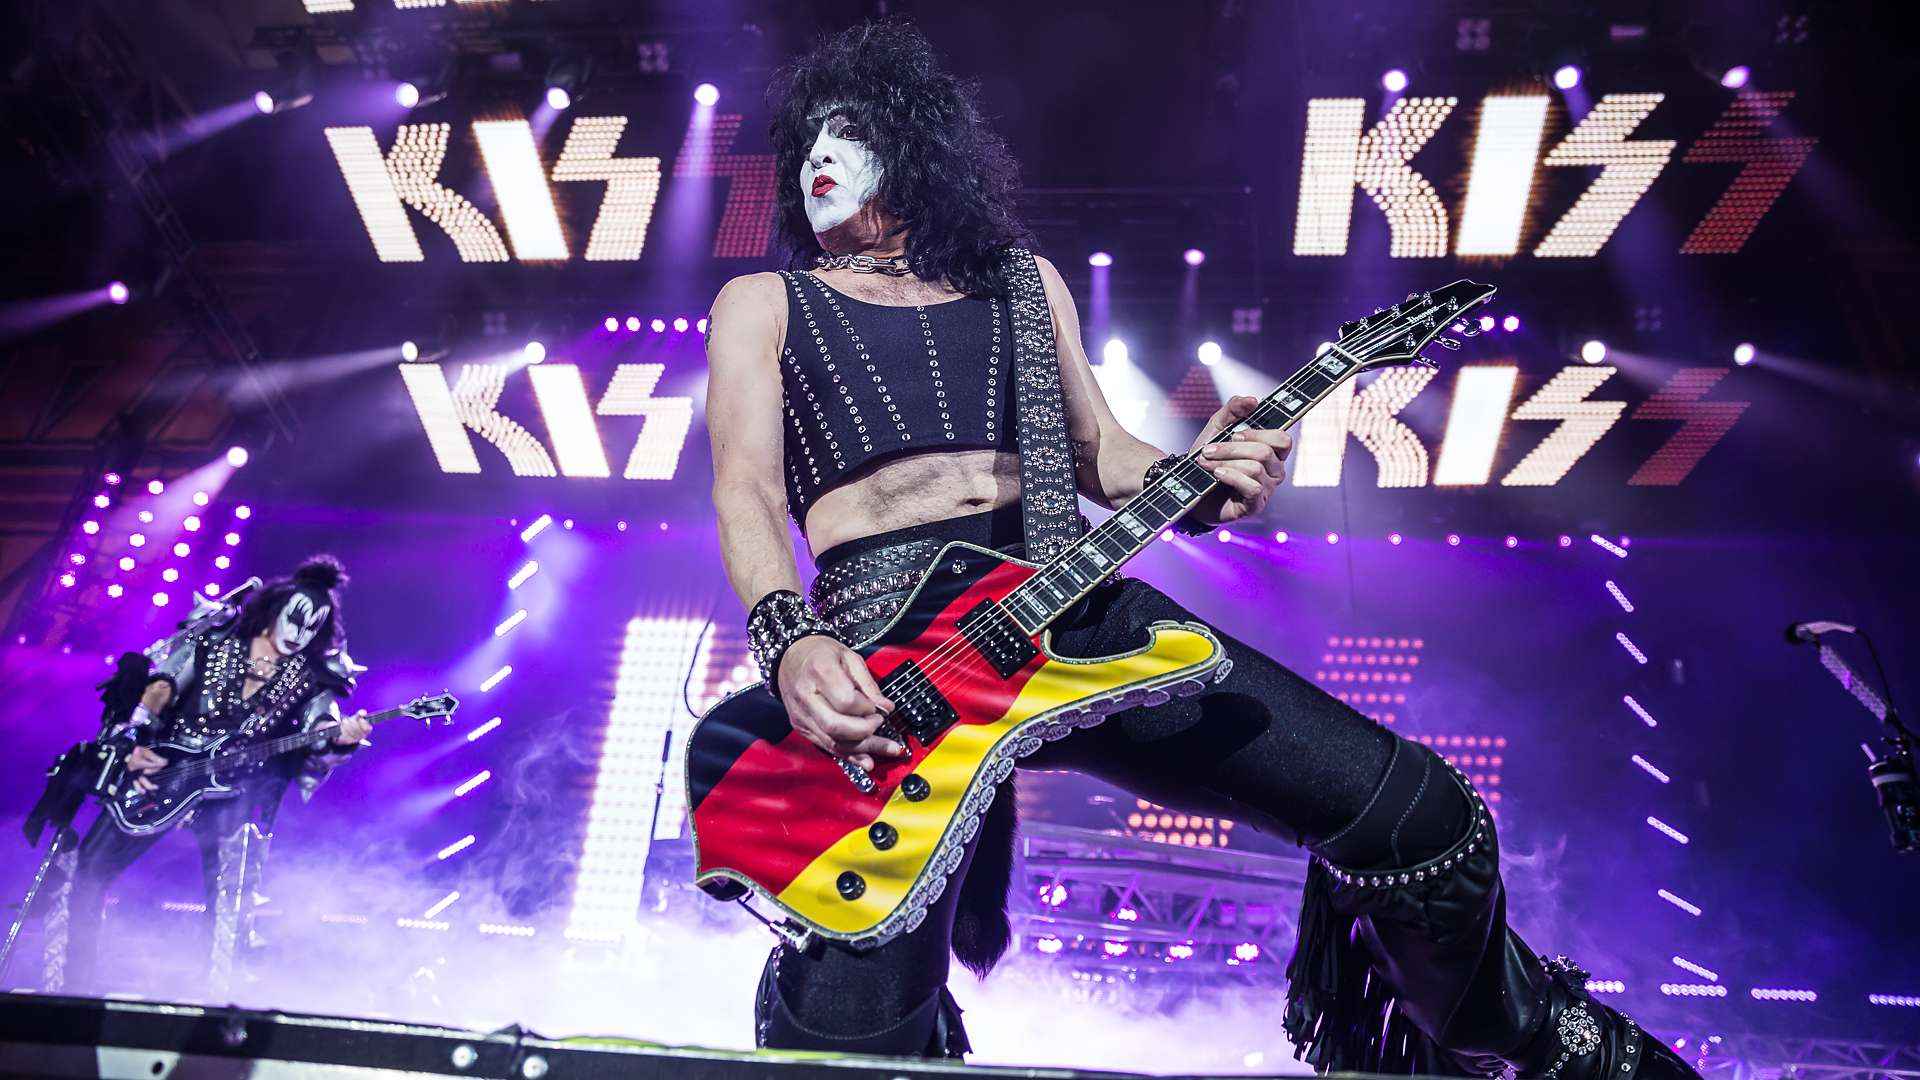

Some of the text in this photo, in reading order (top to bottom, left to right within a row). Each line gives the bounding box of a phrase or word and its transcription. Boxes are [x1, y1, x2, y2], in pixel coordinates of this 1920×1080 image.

[324, 114, 777, 262] KISS
[1293, 91, 1819, 257] KISS
[398, 363, 693, 480] KIS
[1292, 365, 1752, 488] KISS
